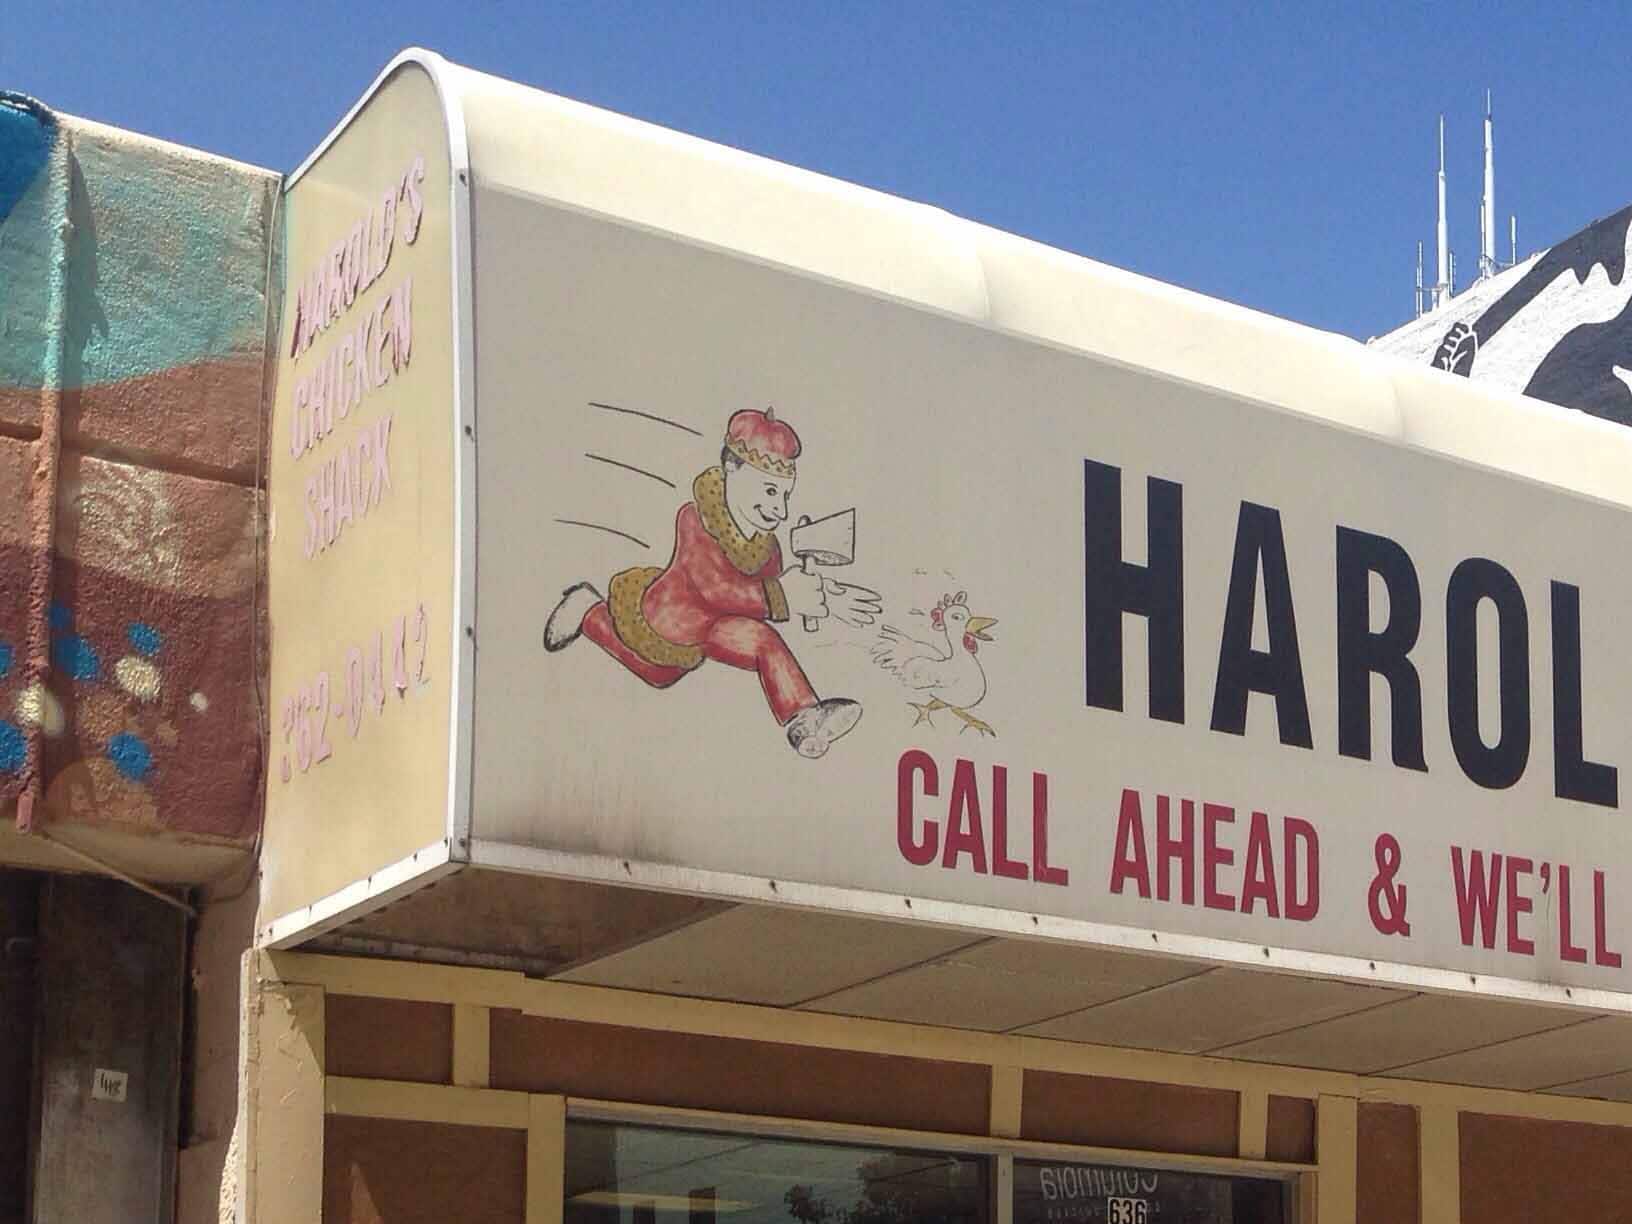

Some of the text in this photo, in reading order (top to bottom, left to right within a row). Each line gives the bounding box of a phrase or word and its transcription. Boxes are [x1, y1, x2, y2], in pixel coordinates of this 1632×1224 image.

[289, 156, 426, 362] HAROLD'S
[289, 272, 413, 461] CHICKEN
[302, 413, 394, 560] SHACK
[895, 747, 1068, 887] CALL
[1110, 788, 1320, 922] AHEAD
[1367, 831, 1410, 937] &
[1450, 844, 1623, 969] WE'LL
